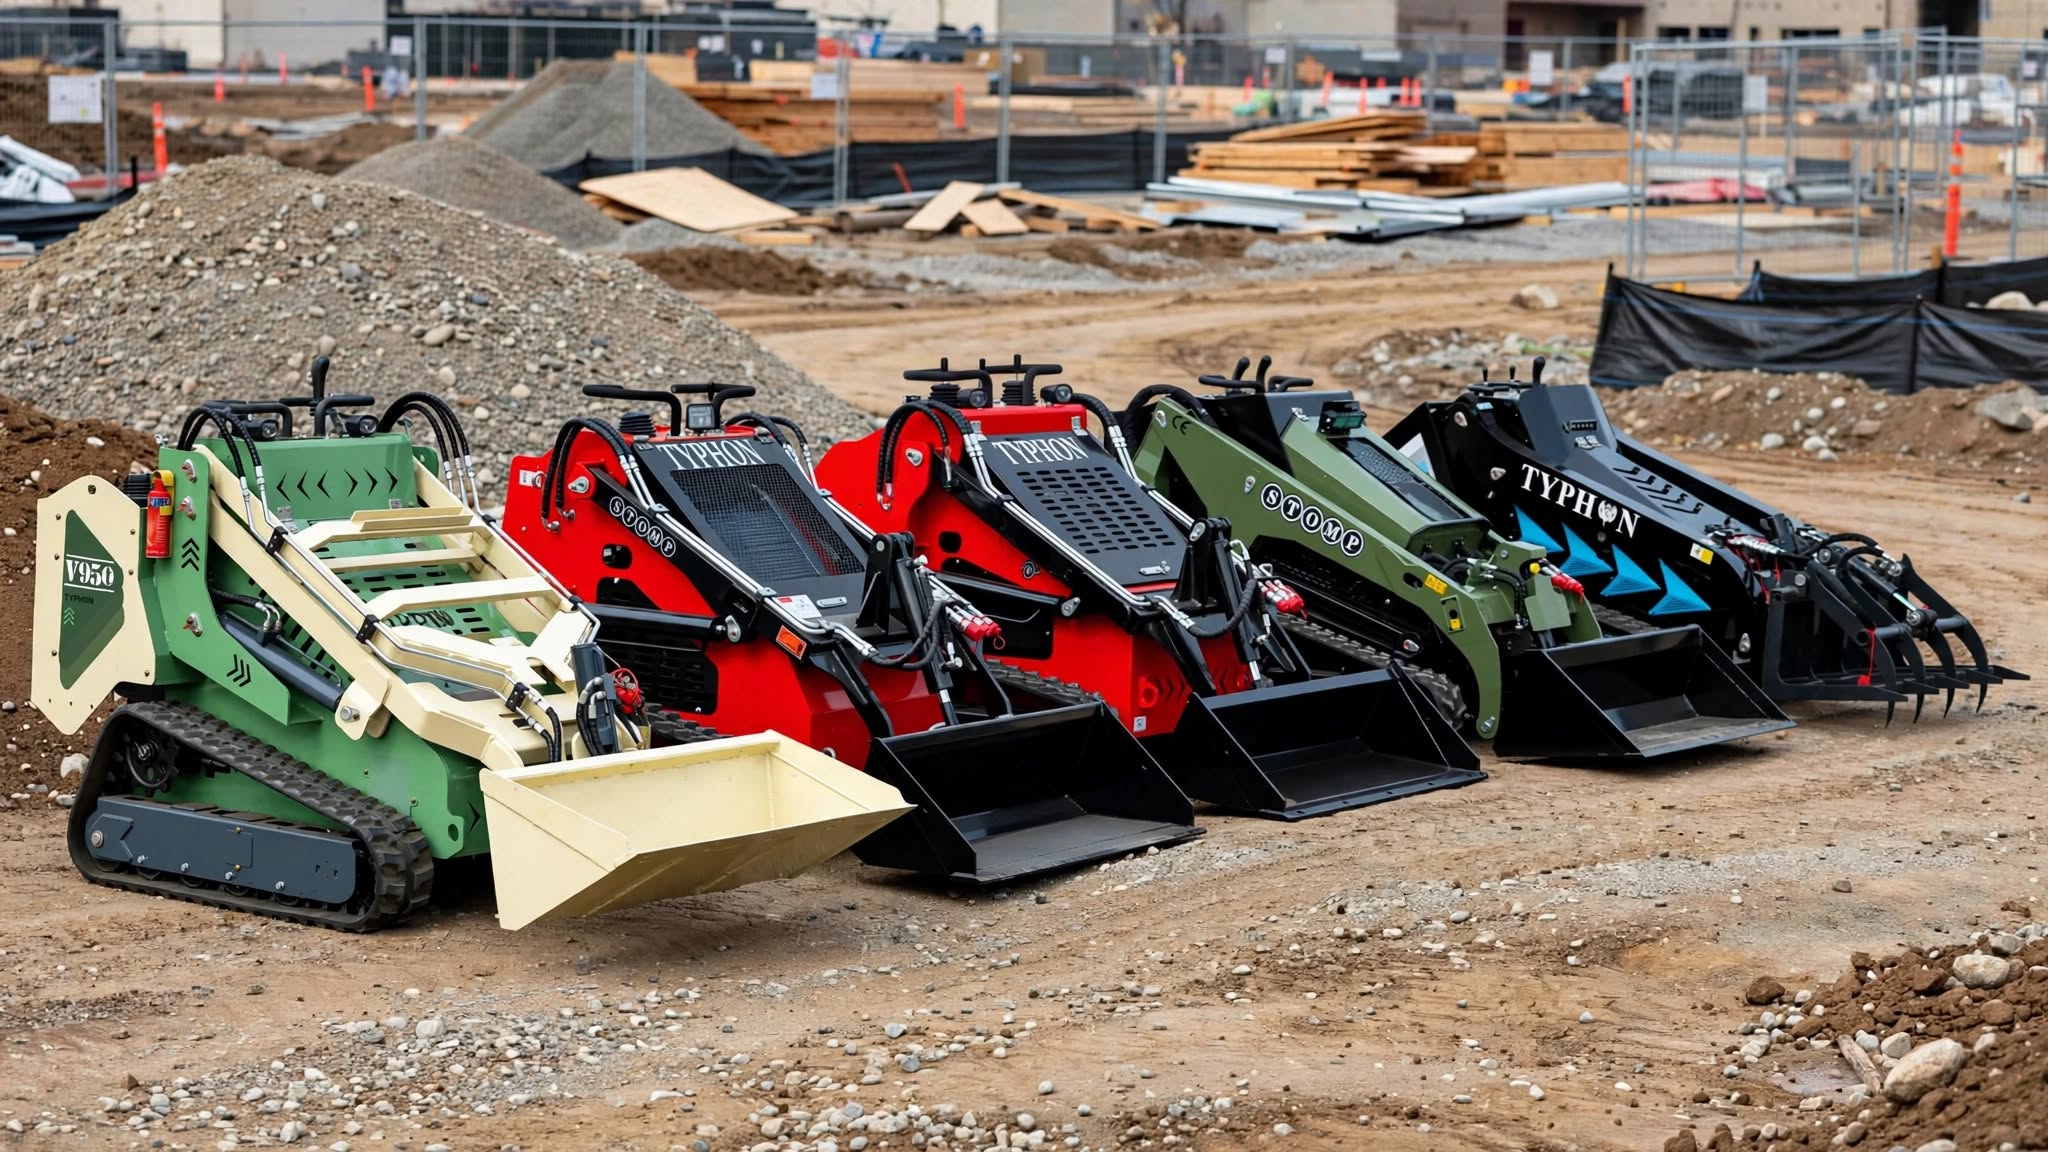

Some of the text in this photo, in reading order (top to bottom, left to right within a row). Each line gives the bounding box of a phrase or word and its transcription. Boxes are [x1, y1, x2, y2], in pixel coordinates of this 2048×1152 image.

[656, 439, 767, 470] TYPHON
[992, 436, 1089, 465] TYPHON
[1263, 486, 1361, 553] STOMP
[1520, 463, 1641, 538] TYPHON
[612, 499, 674, 555] STOMP
[65, 559, 115, 587] V950
